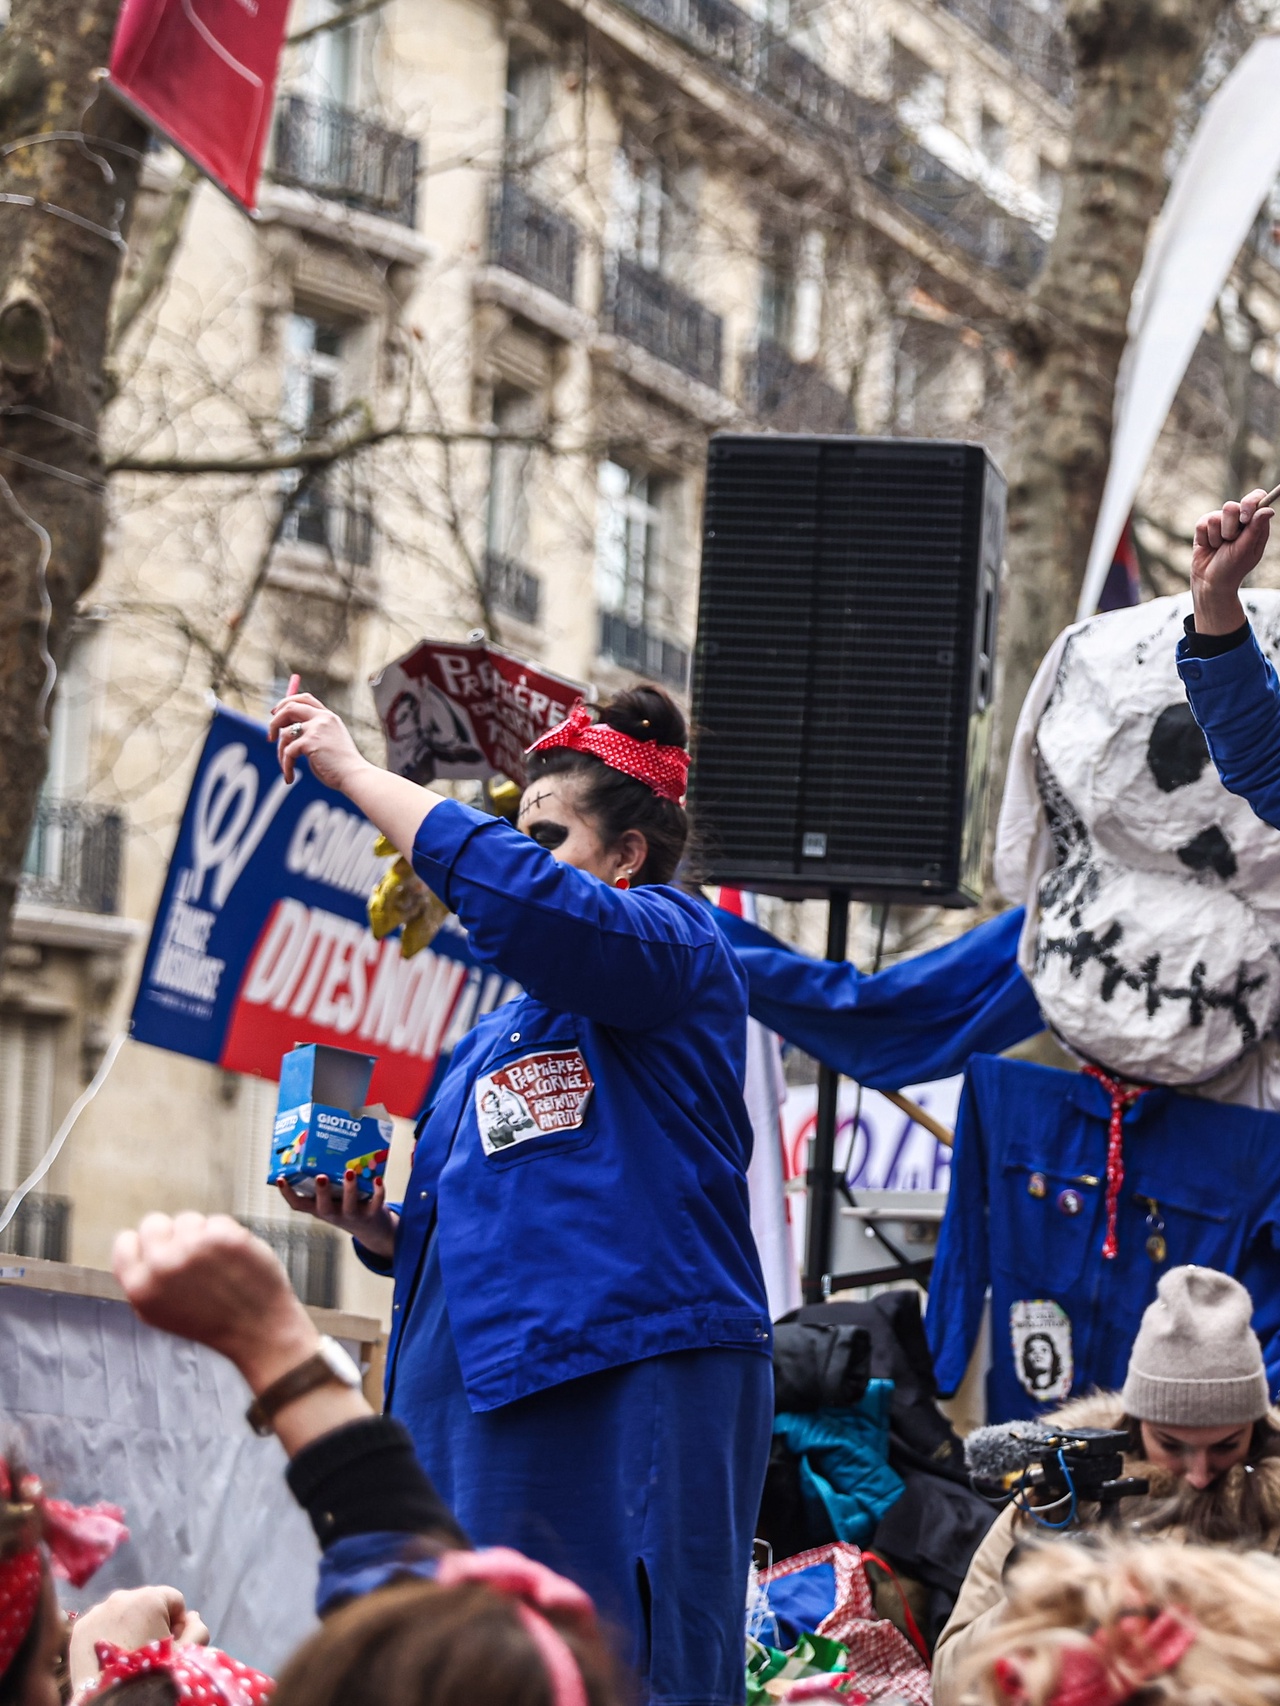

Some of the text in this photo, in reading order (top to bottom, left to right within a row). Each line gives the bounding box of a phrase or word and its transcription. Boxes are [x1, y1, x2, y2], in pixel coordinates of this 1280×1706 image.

[433, 652, 567, 727] PREMIÈRE
[244, 897, 383, 1034] DITES
[357, 936, 467, 1061] NON
[317, 1113, 362, 1132] GIOTTO
